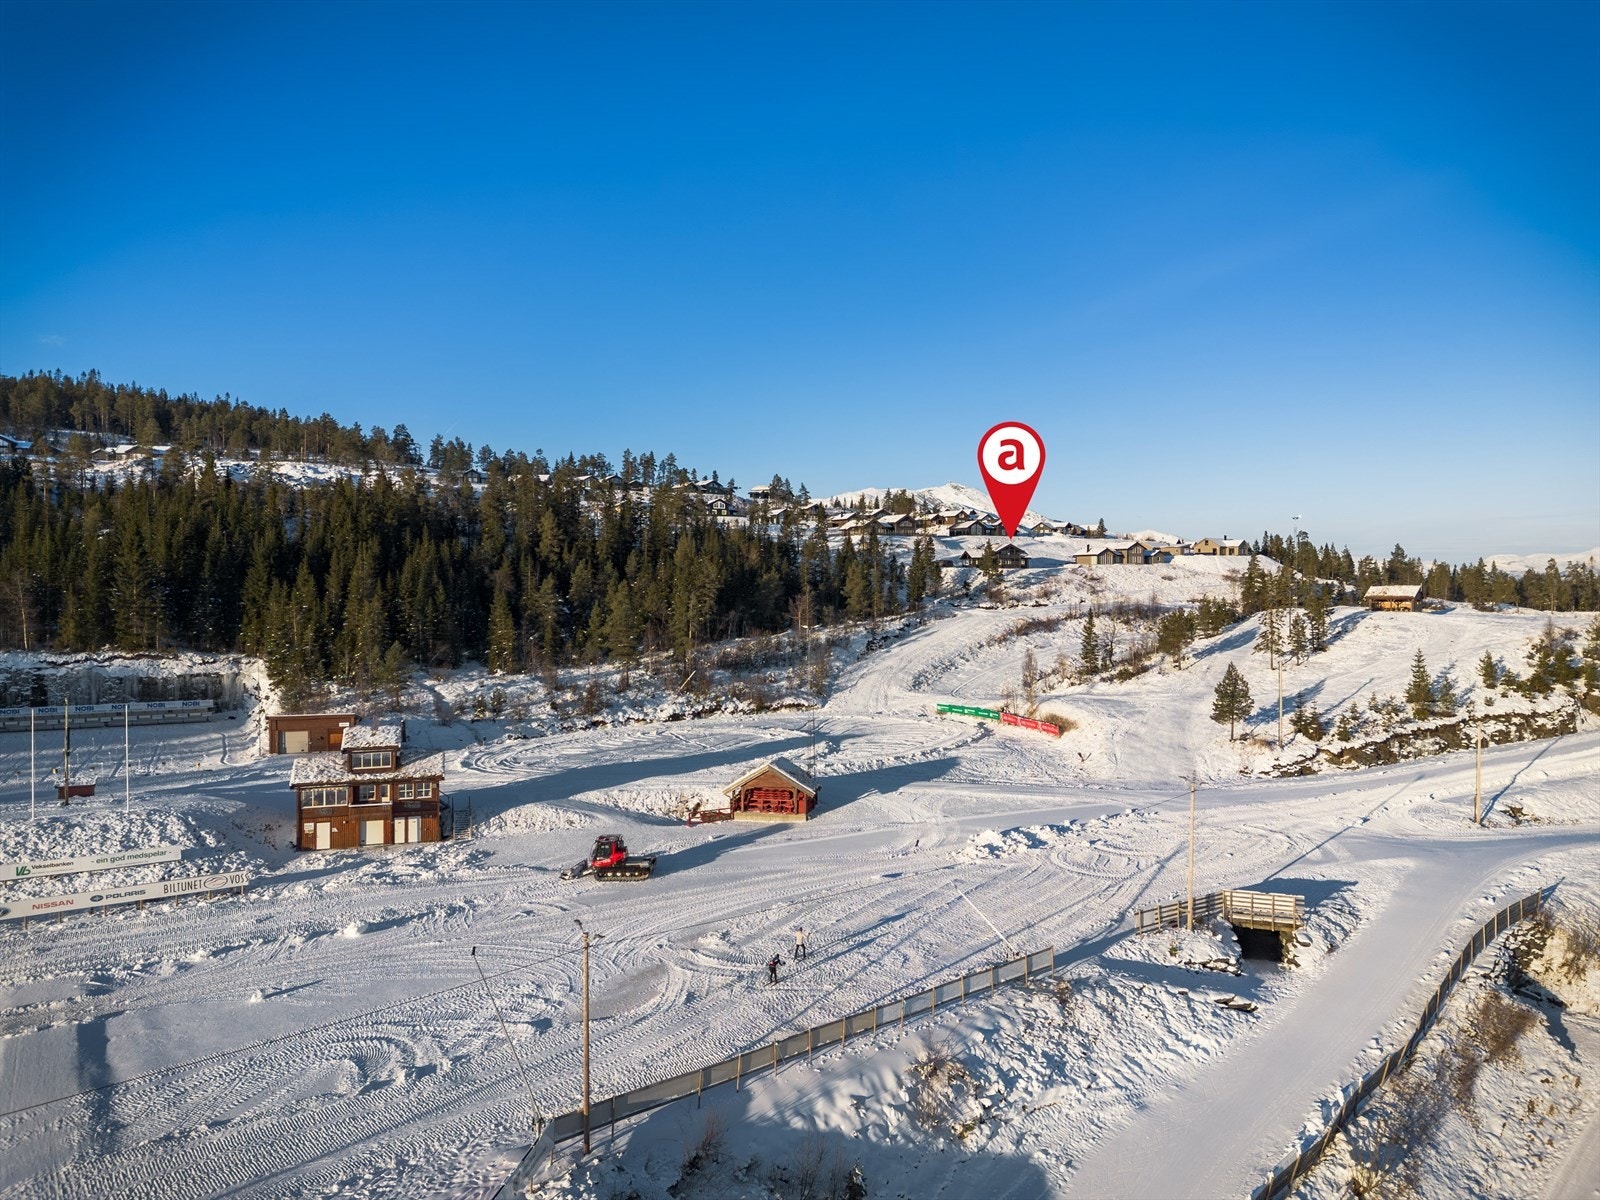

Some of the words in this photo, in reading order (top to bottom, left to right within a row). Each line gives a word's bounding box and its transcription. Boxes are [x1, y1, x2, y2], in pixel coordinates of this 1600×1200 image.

[110, 854, 126, 863] god
[127, 850, 167, 860] medspelar
[31, 862, 74, 870] Vekselbanken
[163, 879, 203, 894] BILTUNET
[229, 874, 249, 884] VOSS
[106, 889, 146, 900] POLARIS
[32, 899, 74, 911] NISSAN
